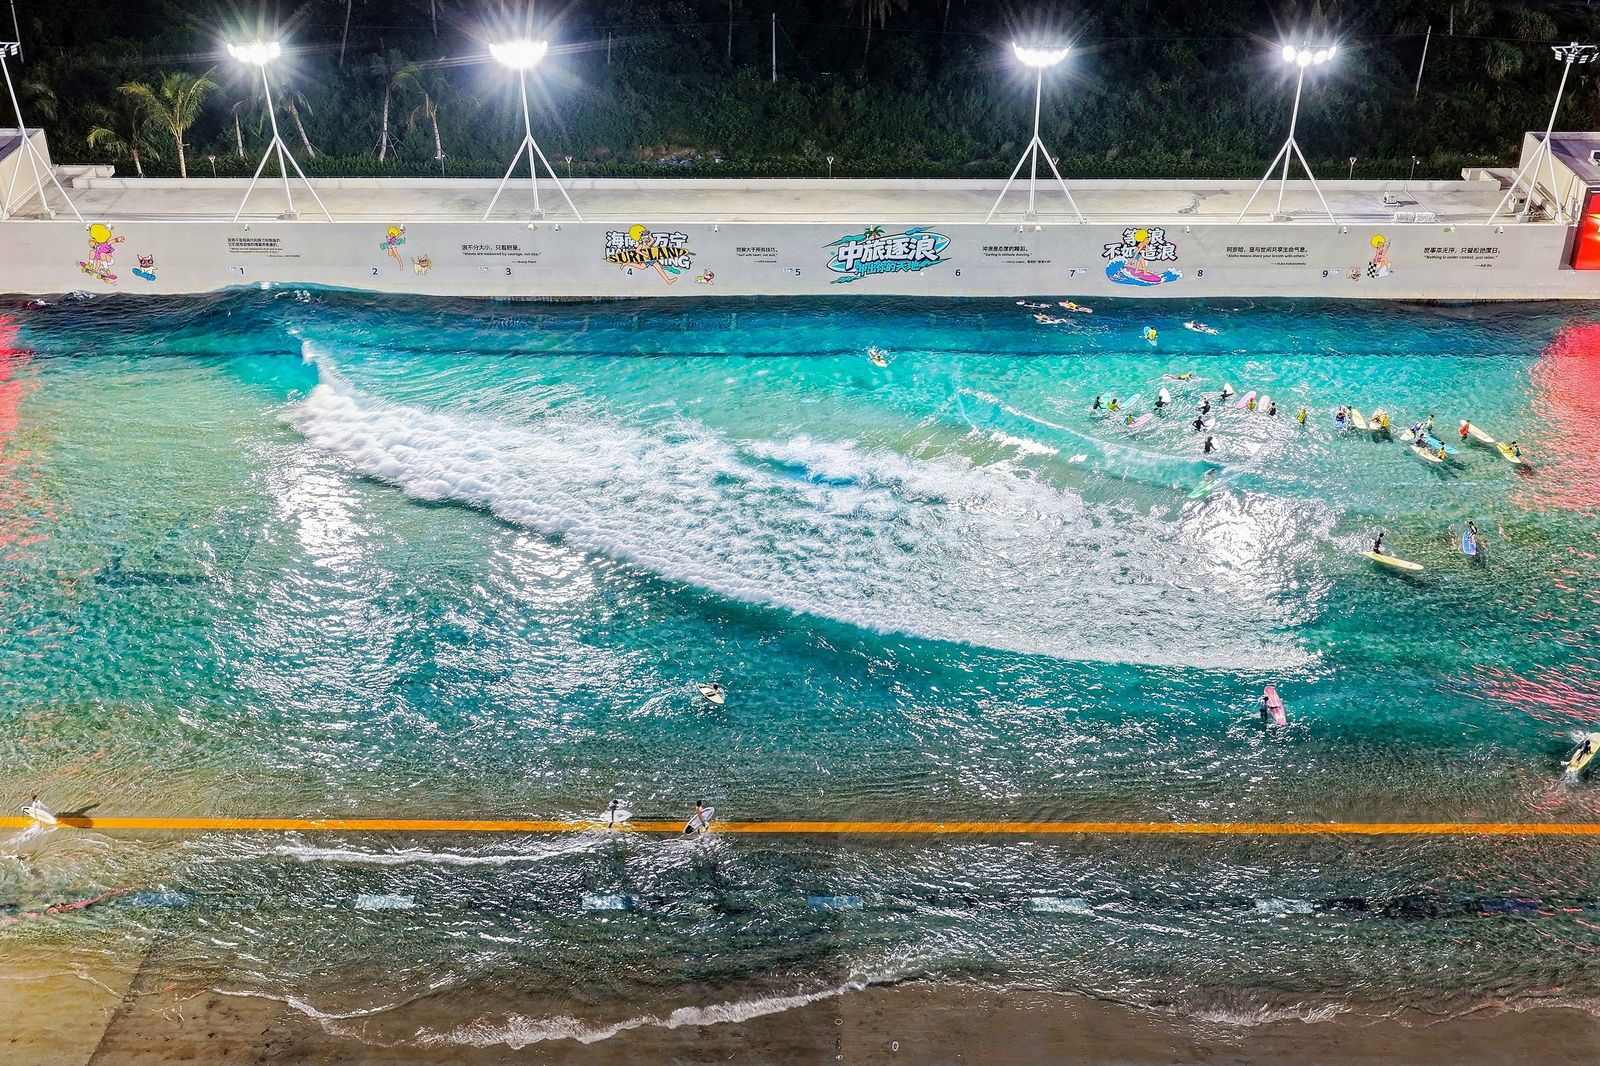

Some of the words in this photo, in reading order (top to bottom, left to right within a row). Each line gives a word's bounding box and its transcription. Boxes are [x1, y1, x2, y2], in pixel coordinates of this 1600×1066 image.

[838, 235, 940, 271] 中旅逐浪
[239, 267, 245, 275] 1
[371, 267, 379, 275] 2
[505, 267, 512, 276] 3
[626, 268, 633, 276] 4
[795, 268, 801, 276] 5
[955, 268, 961, 277] 6
[1069, 269, 1076, 278] 7
[1197, 269, 1204, 277] 8
[1322, 269, 1329, 278] 9
